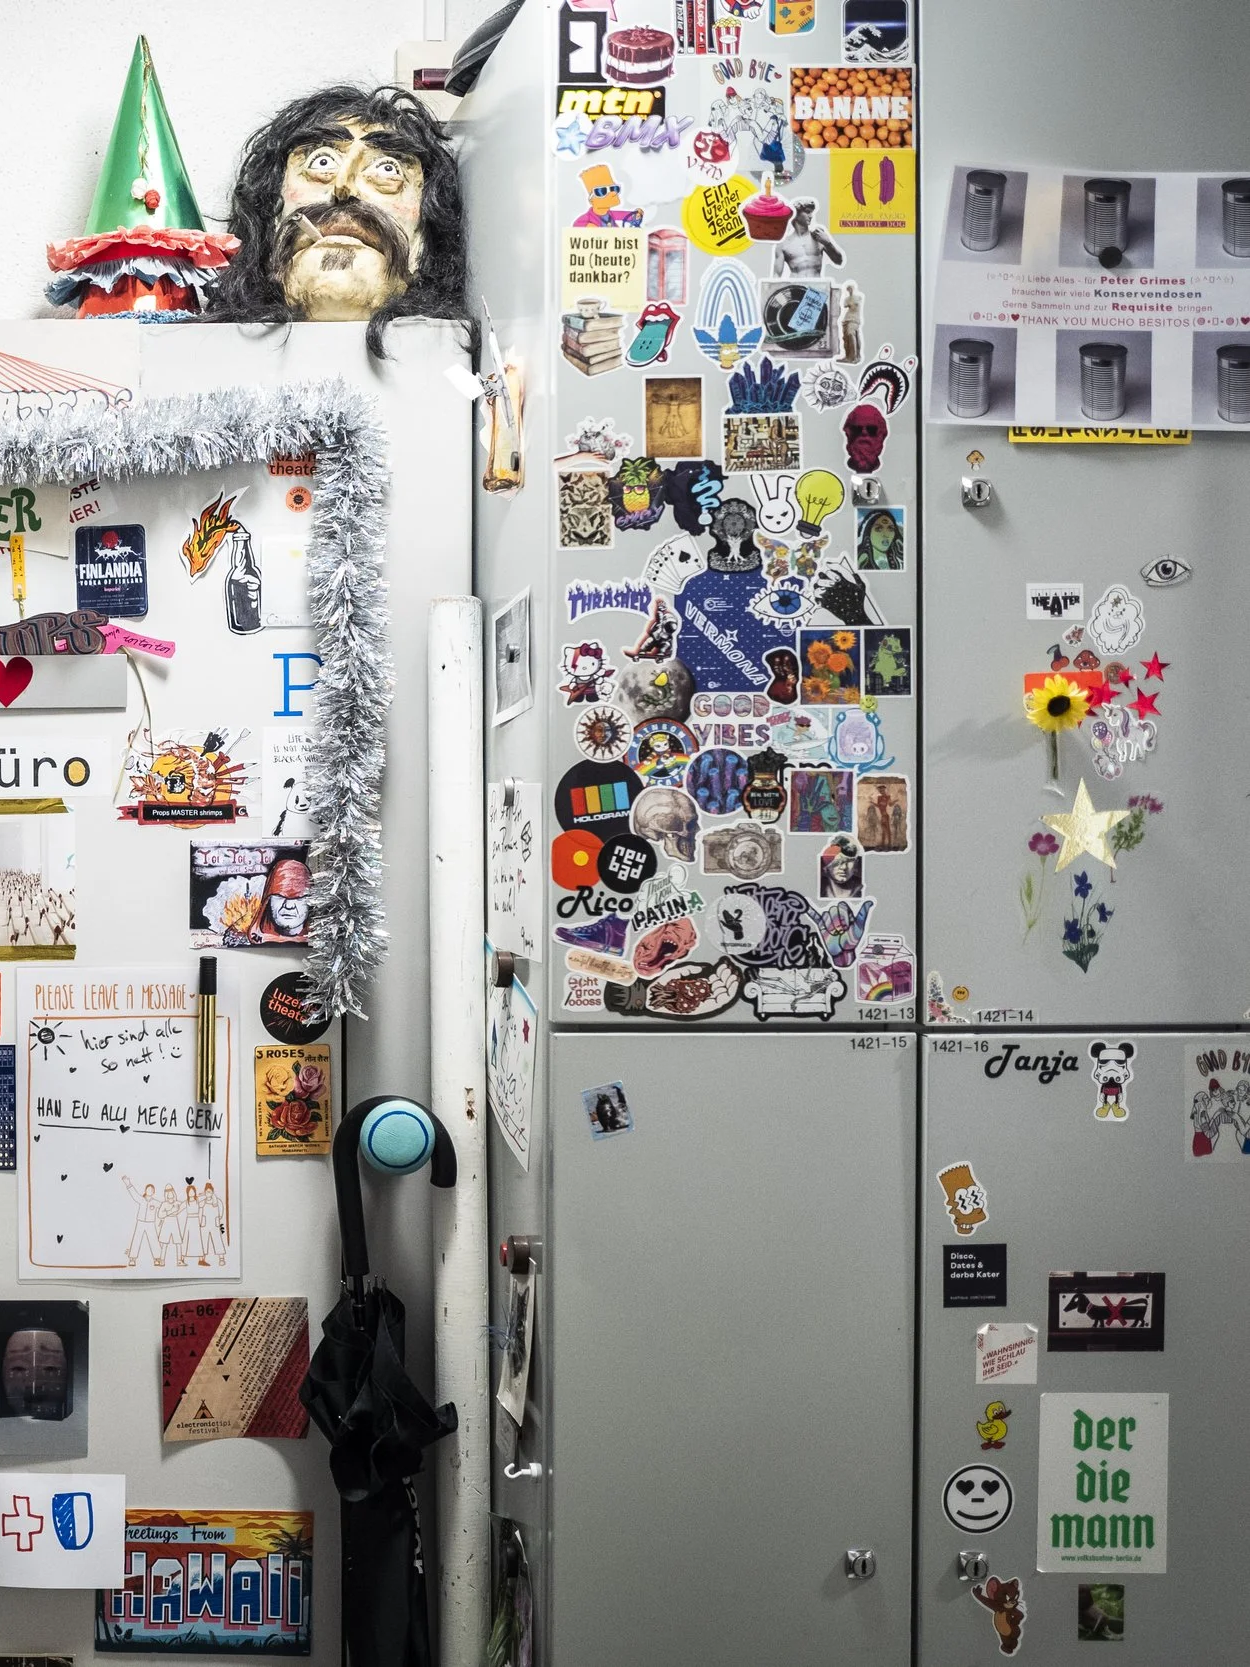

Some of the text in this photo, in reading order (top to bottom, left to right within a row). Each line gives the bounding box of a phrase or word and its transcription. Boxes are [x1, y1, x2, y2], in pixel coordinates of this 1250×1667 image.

[559, 87, 654, 114] mtn
[794, 96, 909, 120] BANANE
[585, 114, 694, 151] BMX
[703, 182, 730, 207] Ein
[569, 237, 639, 251] Wofür bist
[569, 253, 637, 269] Du (heute)
[569, 271, 630, 284] dankbar?
[1100, 276, 1134, 285] Peter
[1139, 276, 1186, 285] Grimes
[1094, 289, 1202, 299] Konservendosen
[1074, 303, 1090, 311] und
[1112, 302, 1173, 313] Requisite
[1178, 304, 1213, 313] bringen
[1021, 315, 1190, 328] THANK YOU MUCHO BESITOS
[79, 561, 143, 580] FINLANDIA
[569, 582, 651, 622] THRASHER
[1031, 595, 1080, 616] THEATER
[685, 600, 769, 686] VERMONA
[693, 693, 771, 718] GOOD
[693, 723, 771, 747] VIBES
[152, 809, 170, 818] Props
[199, 809, 223, 818] shrimps
[573, 810, 632, 824] HOLOGRAM
[556, 885, 634, 919] Rico
[35, 983, 187, 1011] PLEASE LEAVE A MESSAGE
[857, 1007, 915, 1021] 1421-13
[976, 1010, 1034, 1023] 1421-14
[80, 1017, 183, 1052] hier sind alle
[850, 1037, 907, 1050] 1421-15
[266, 1049, 305, 1059] ROSES
[931, 1040, 989, 1053] 1421-16
[984, 1044, 1079, 1085] Tanja
[37, 1096, 62, 1118] HAN
[71, 1100, 90, 1121] EU
[137, 1106, 178, 1128] MEGA
[186, 1108, 224, 1131] GERN
[950, 1252, 976, 1261] Disco,
[977, 1261, 984, 1269] &
[950, 1270, 1000, 1279] derbe Kater
[162, 1324, 197, 1338] Juli
[982, 1347, 1026, 1369] WIE SCHLAU
[982, 1367, 995, 1377] IHR
[188, 1426, 220, 1435] festival
[1072, 1408, 1137, 1452] der
[1075, 1460, 1131, 1504] die
[186, 1522, 227, 1542] From
[1050, 1513, 1155, 1549] mann
[110, 1551, 305, 1627] HAWAII
